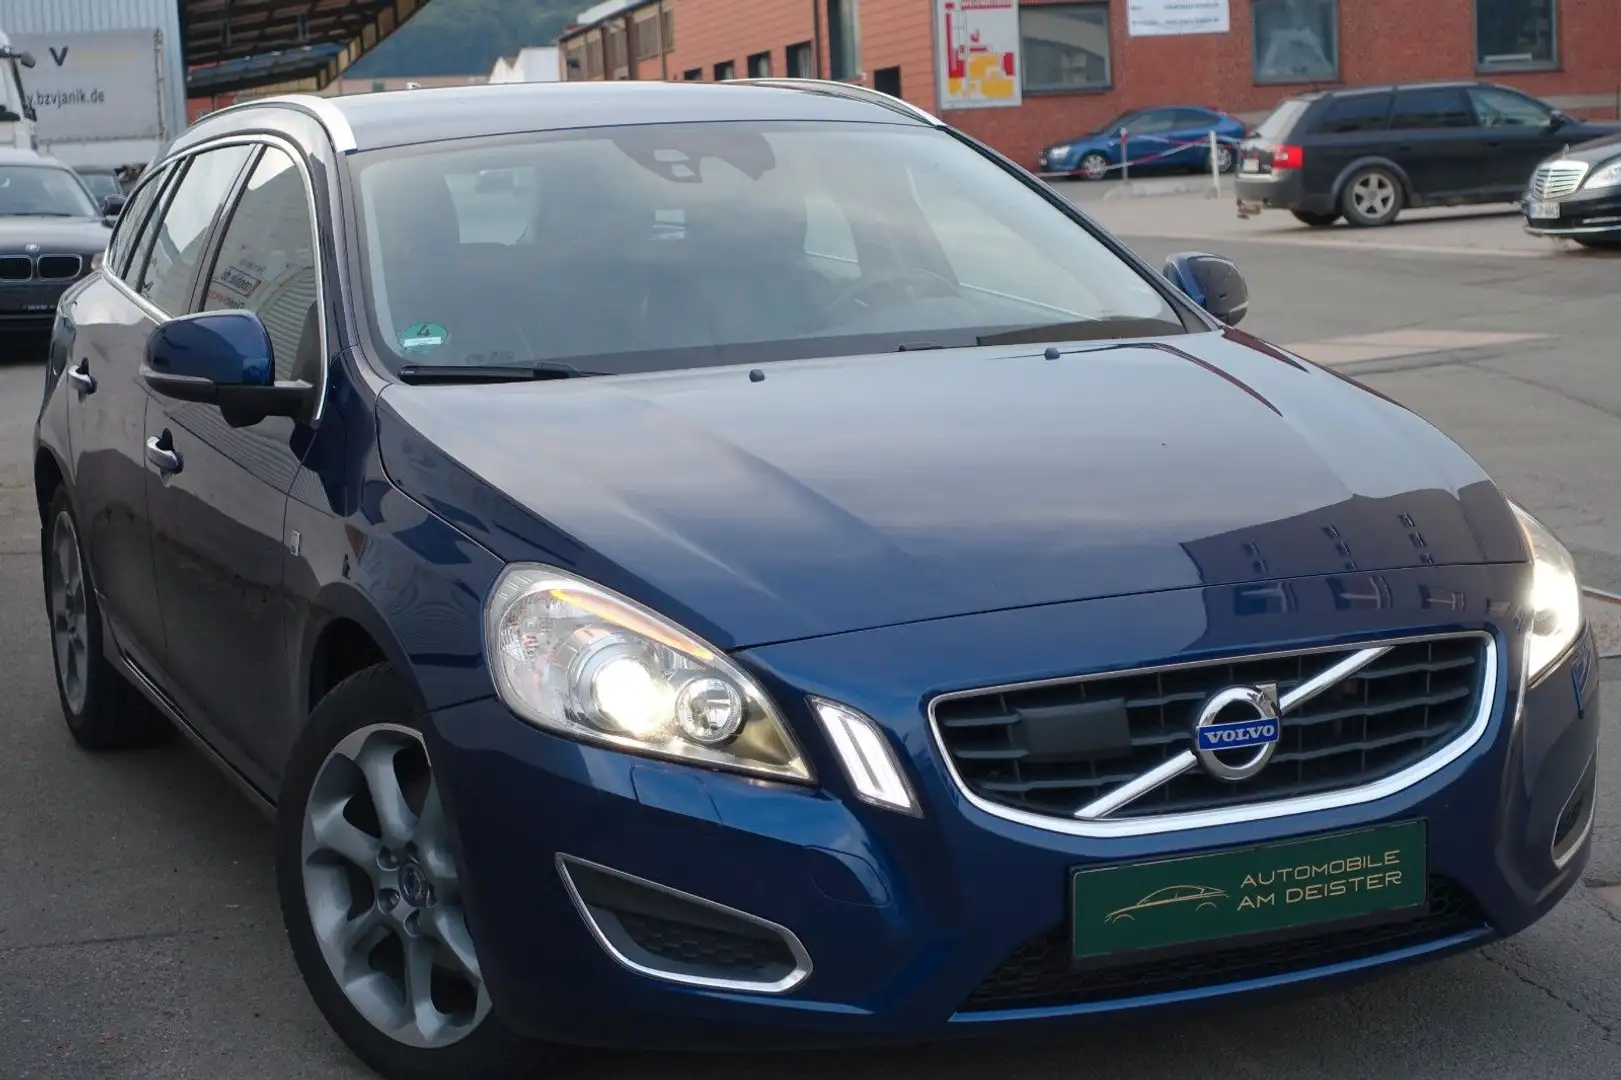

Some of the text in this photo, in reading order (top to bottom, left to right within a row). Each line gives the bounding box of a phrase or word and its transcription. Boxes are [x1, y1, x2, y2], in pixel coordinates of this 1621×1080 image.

[416, 324, 431, 337] 4
[1204, 725, 1274, 743] VOLVO
[1240, 850, 1400, 889] AUTOMOBILE
[1236, 870, 1403, 911] AM DEISTER
